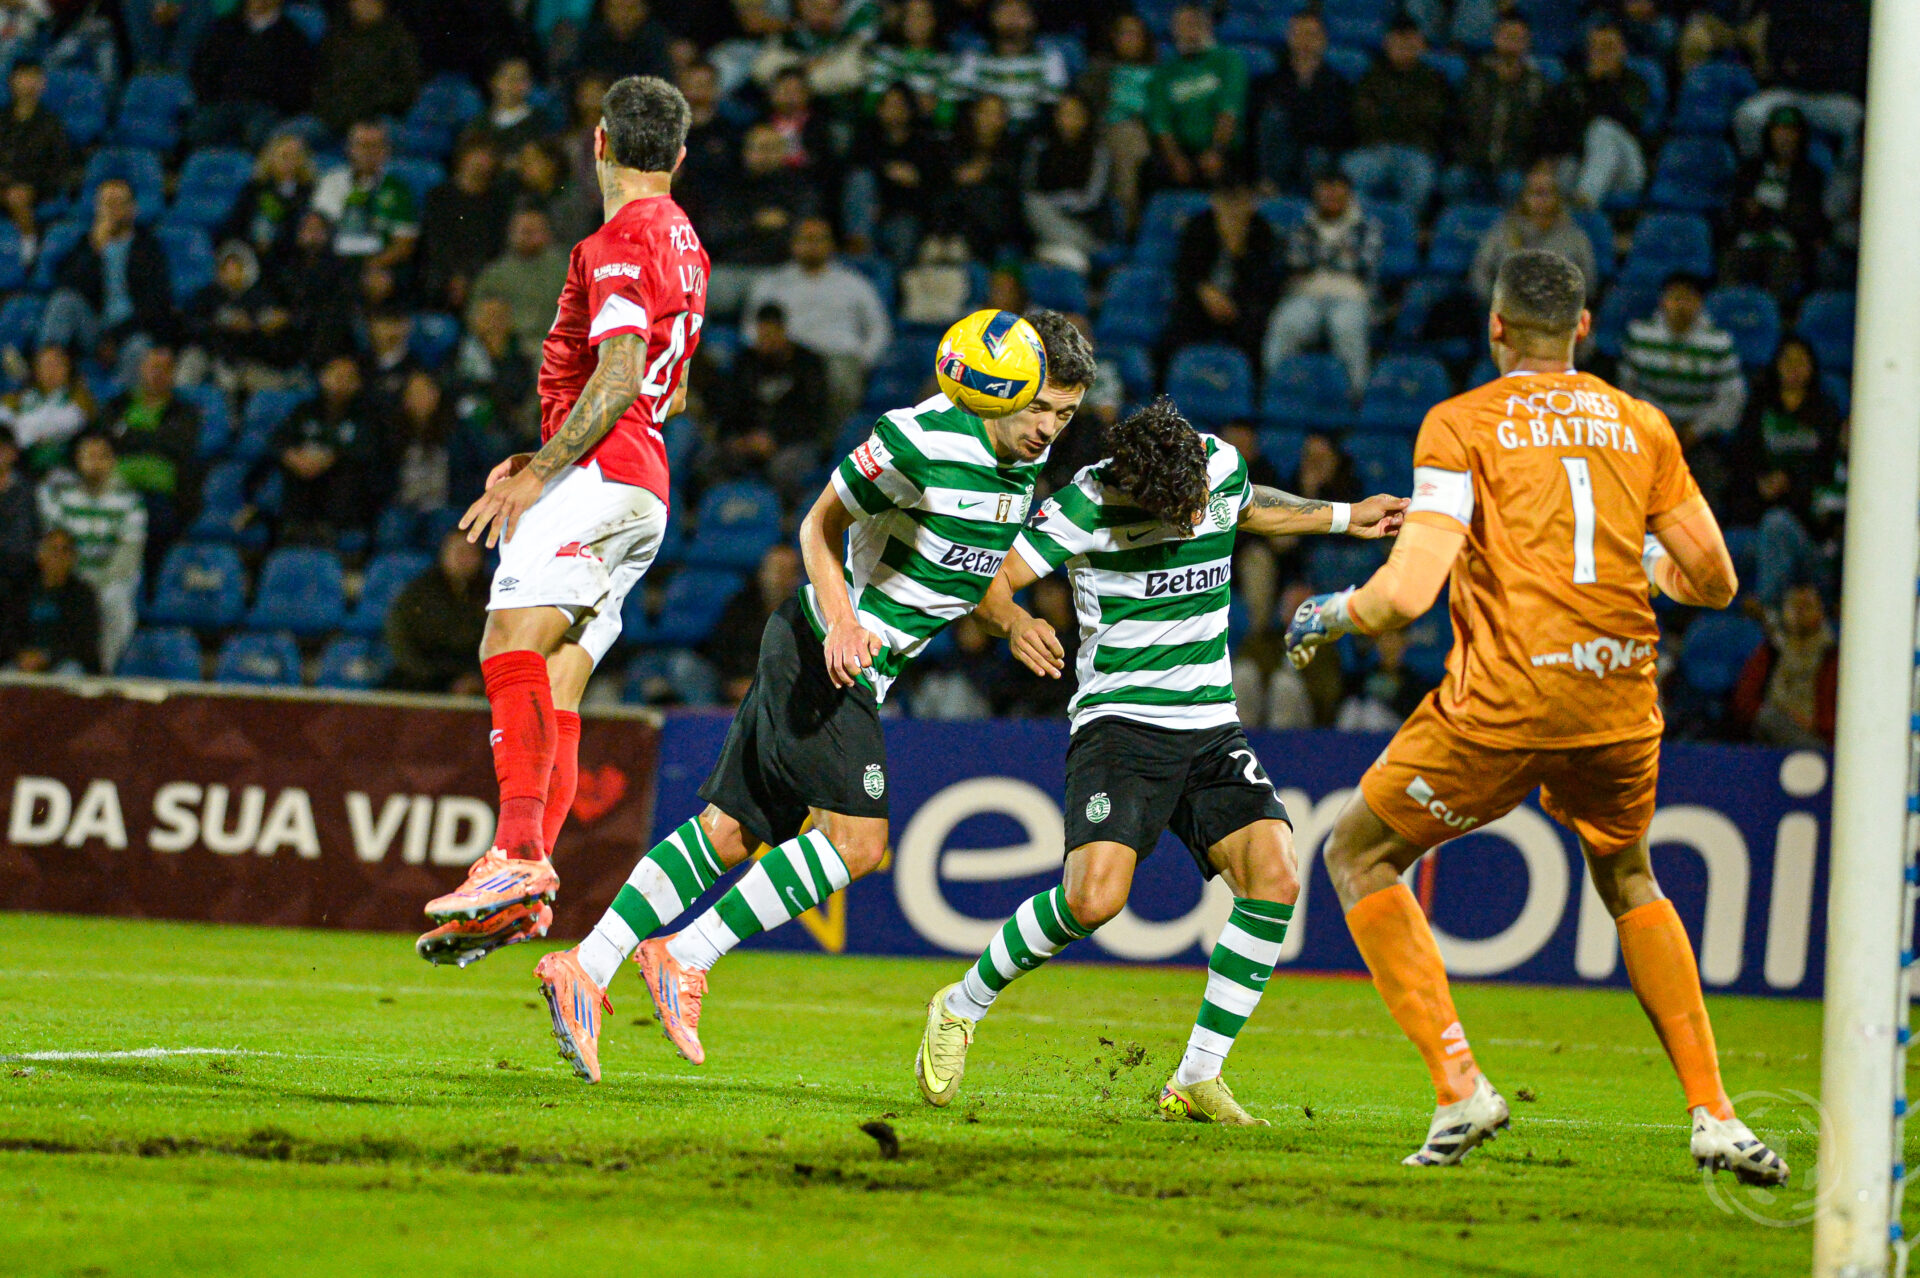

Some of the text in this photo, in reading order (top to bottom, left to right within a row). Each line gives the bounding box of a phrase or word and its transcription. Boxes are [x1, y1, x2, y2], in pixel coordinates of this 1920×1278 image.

[1505, 389, 1619, 421] AÇORES
[1560, 457, 1597, 584] 1
[939, 543, 1003, 575] Betan
[1144, 563, 1230, 597] Betano
[7, 776, 497, 867] DA SUA VID
[893, 751, 1828, 990] eroni
